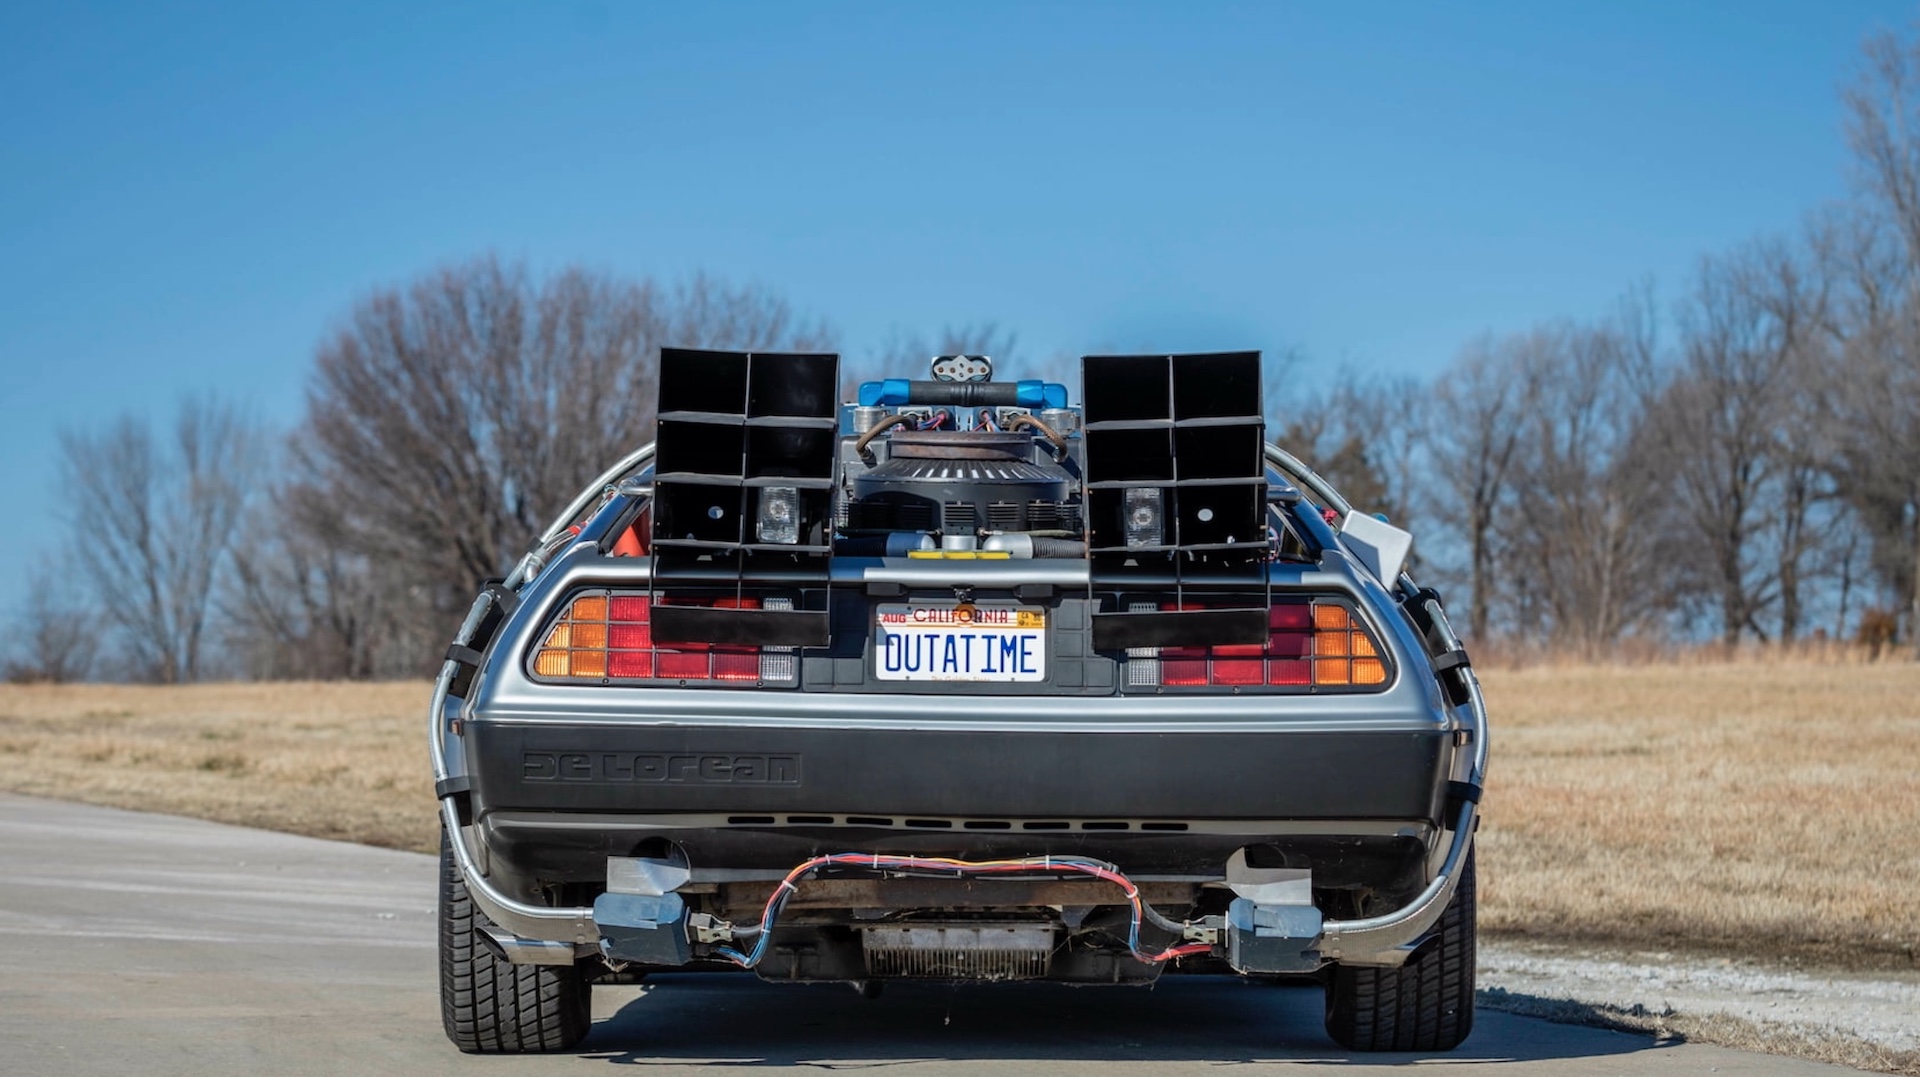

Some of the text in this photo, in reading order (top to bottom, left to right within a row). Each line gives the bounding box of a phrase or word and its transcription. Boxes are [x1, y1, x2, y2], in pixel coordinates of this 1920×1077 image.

[882, 613, 906, 623] AUG
[913, 608, 1008, 623] CALIFORNIA
[885, 634, 1037, 673] OUTATIME
